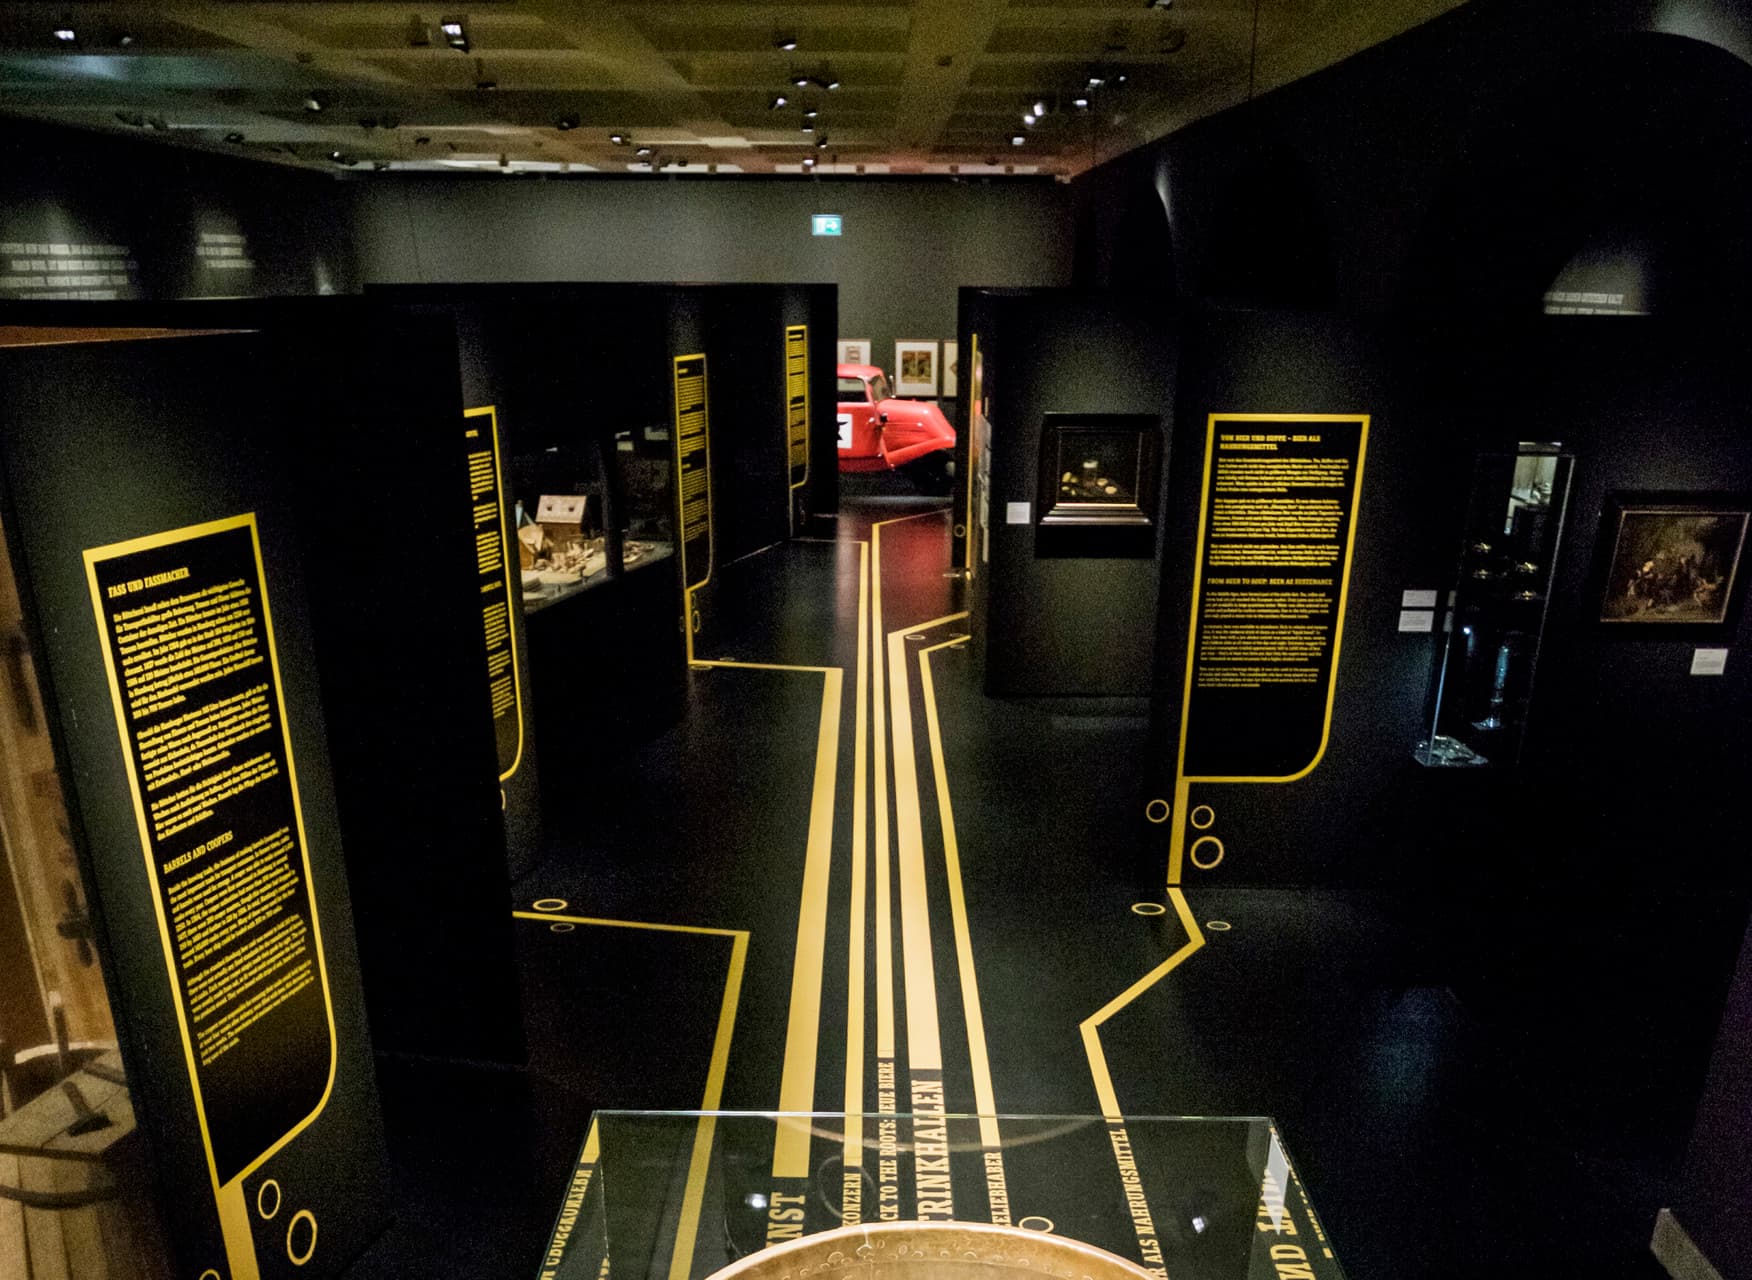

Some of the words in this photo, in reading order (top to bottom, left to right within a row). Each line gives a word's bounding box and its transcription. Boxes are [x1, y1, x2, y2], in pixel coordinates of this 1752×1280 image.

[108, 582, 127, 598] FASS
[127, 579, 144, 593] UND
[144, 567, 190, 589] FASSMACHER
[163, 851, 192, 874] BARRELS
[193, 845, 206, 859] AND
[207, 830, 233, 851] COOPERS
[878, 1062, 895, 1089] BIERE
[878, 1119, 897, 1156] ROOTS:
[879, 1159, 898, 1183] THE
[1109, 1129, 1155, 1235] NAHRUNGSMITTEL
[879, 1185, 898, 1201] TO
[766, 1192, 806, 1249] NST
[1139, 1239, 1164, 1264] ALS
